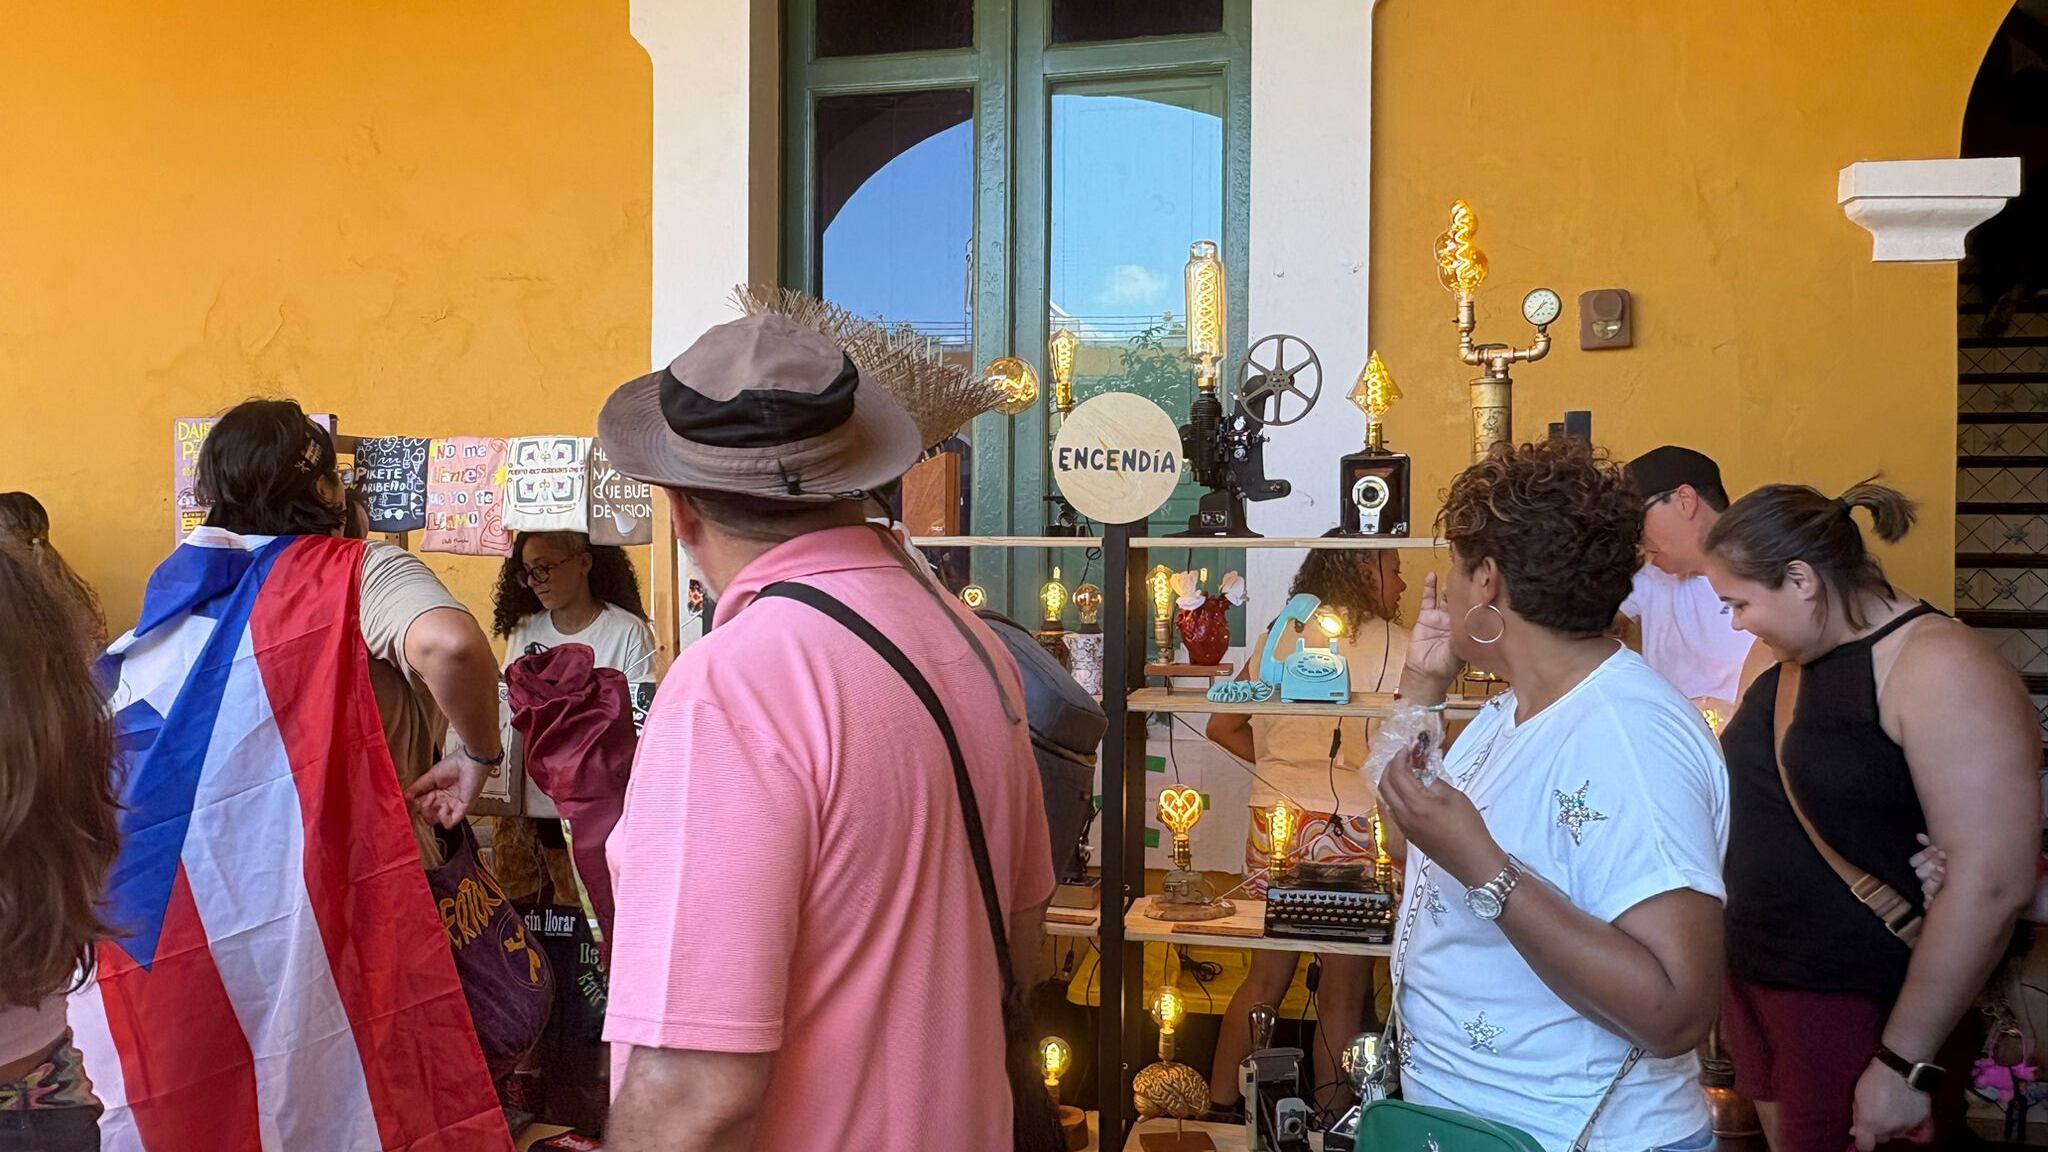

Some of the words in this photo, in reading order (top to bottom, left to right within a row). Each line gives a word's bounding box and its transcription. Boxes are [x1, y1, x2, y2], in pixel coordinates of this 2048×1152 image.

[1058, 446, 1176, 473] ENCENDÍA
[355, 466, 402, 481] PIKETE
[544, 909, 576, 932] llorar
